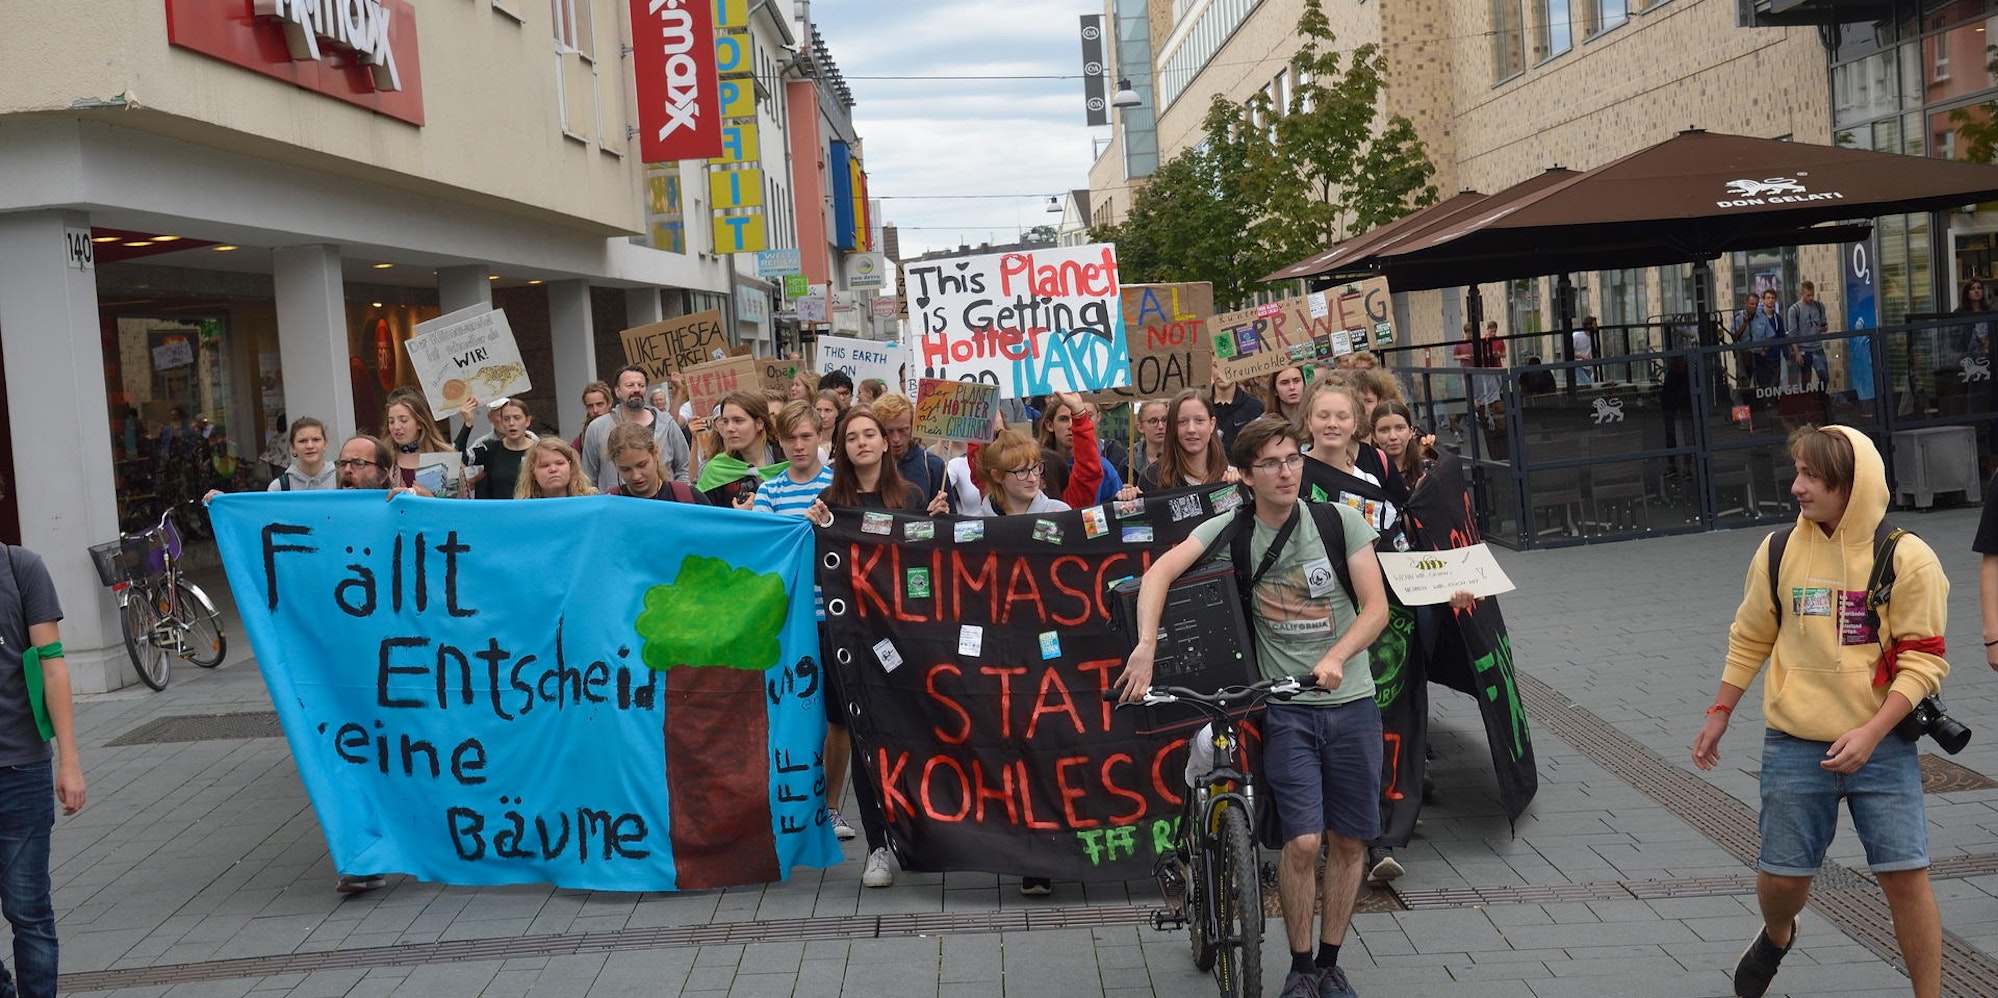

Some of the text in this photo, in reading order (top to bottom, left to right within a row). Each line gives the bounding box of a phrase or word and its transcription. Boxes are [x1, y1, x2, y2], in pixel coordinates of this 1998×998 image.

[1716, 192, 1844, 208] DON GELATI
[67, 232, 92, 263] 140
[910, 262, 985, 299] This
[1000, 247, 1118, 298] Planet
[1853, 243, 1871, 285] O2
[916, 297, 947, 333] is
[963, 295, 1113, 343] Getting
[627, 321, 725, 363] LIKE THE SEA
[922, 325, 1047, 367] Hotter
[1147, 320, 1204, 350] NOT
[452, 346, 490, 368] WIR!
[648, 355, 674, 379] WE
[824, 345, 887, 364] THIS EARTH
[1225, 355, 1286, 379] Braunkohle
[688, 368, 738, 398] KEIN
[920, 383, 950, 397] Der
[955, 385, 998, 404] PLANET
[1756, 380, 1825, 399] DON GELATI
[942, 398, 990, 419] HOTTER
[261, 523, 477, 617] Fällt
[850, 544, 1140, 625] KLIMASC
[1271, 620, 1329, 631] CALIFORNIA
[775, 749, 810, 834] FFF
[446, 796, 651, 864] Bäume
